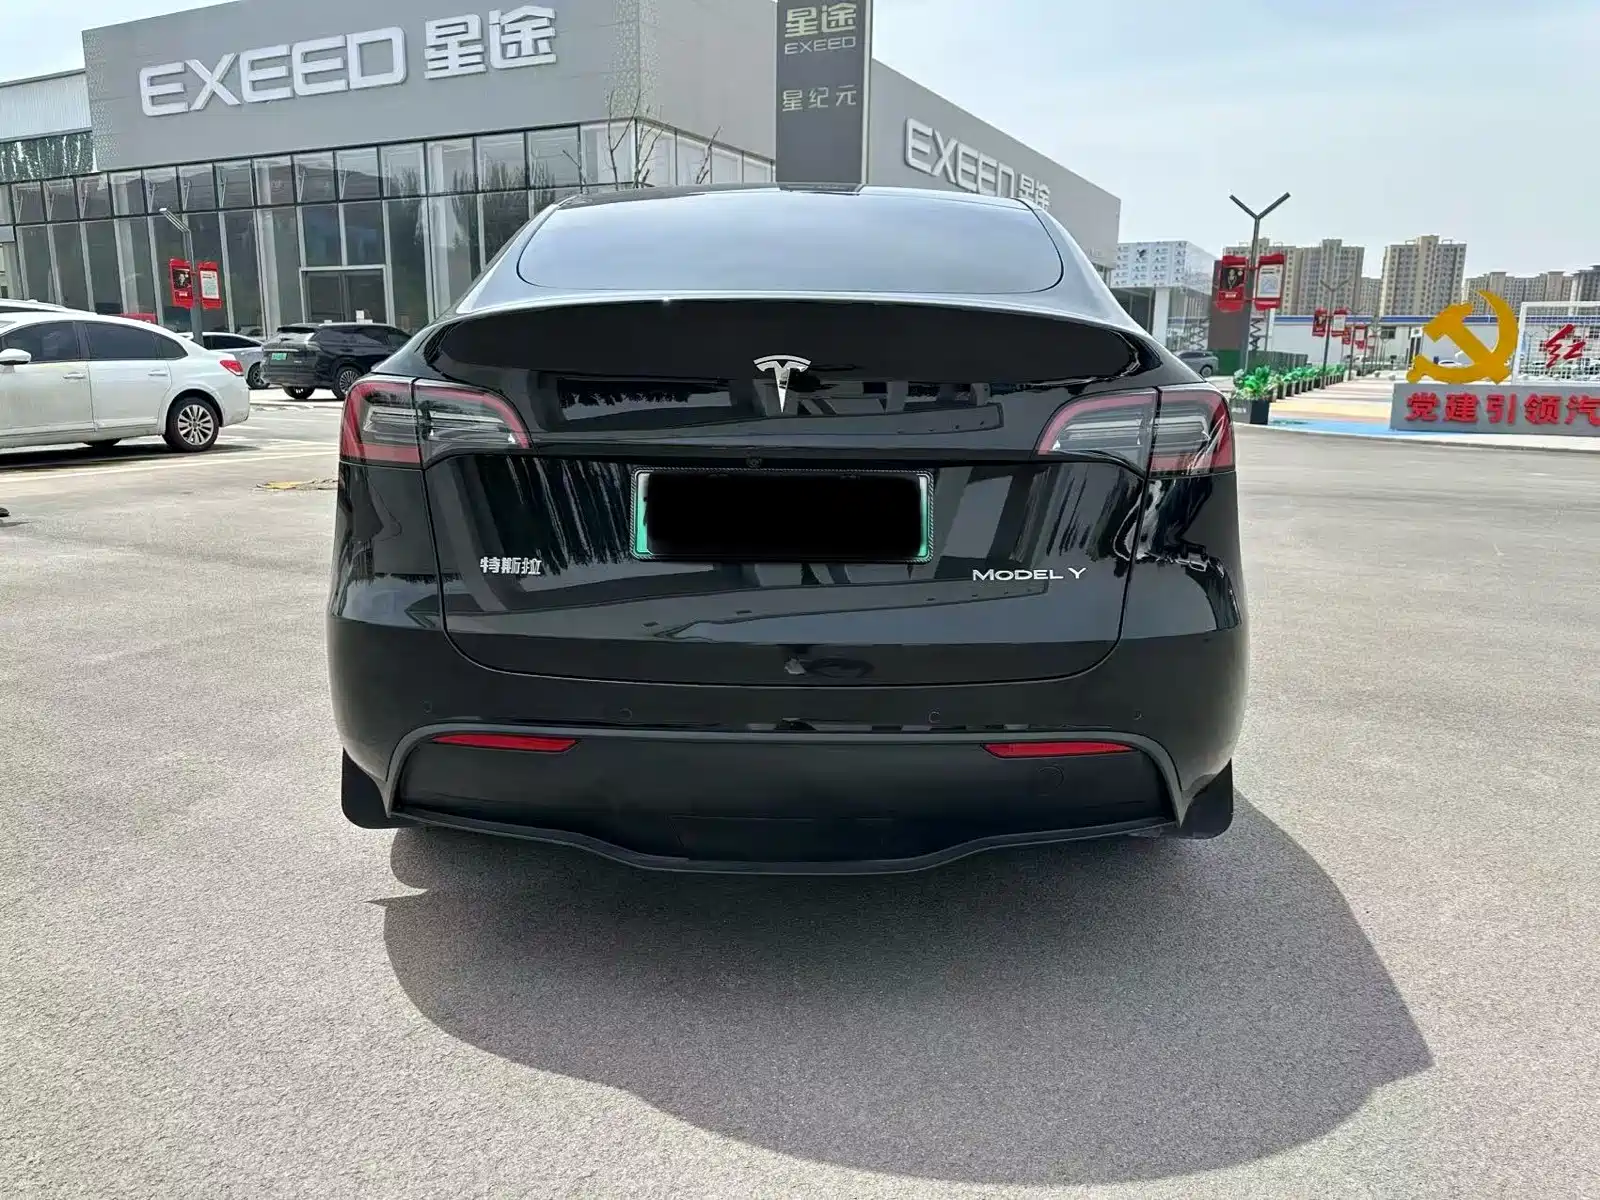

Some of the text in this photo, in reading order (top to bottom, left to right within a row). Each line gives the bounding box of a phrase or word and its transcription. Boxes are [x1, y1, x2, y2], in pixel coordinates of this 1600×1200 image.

[784, 2, 857, 38] 星途
[139, 5, 557, 117] EXEED 星途
[784, 36, 856, 55] EXEED
[782, 85, 857, 112] 星纪元
[1545, 323, 1586, 369] 红
[1404, 391, 1600, 427] 党建引领汽
[480, 556, 542, 575] 特斯拉
[972, 567, 1087, 581] MODEL Y
